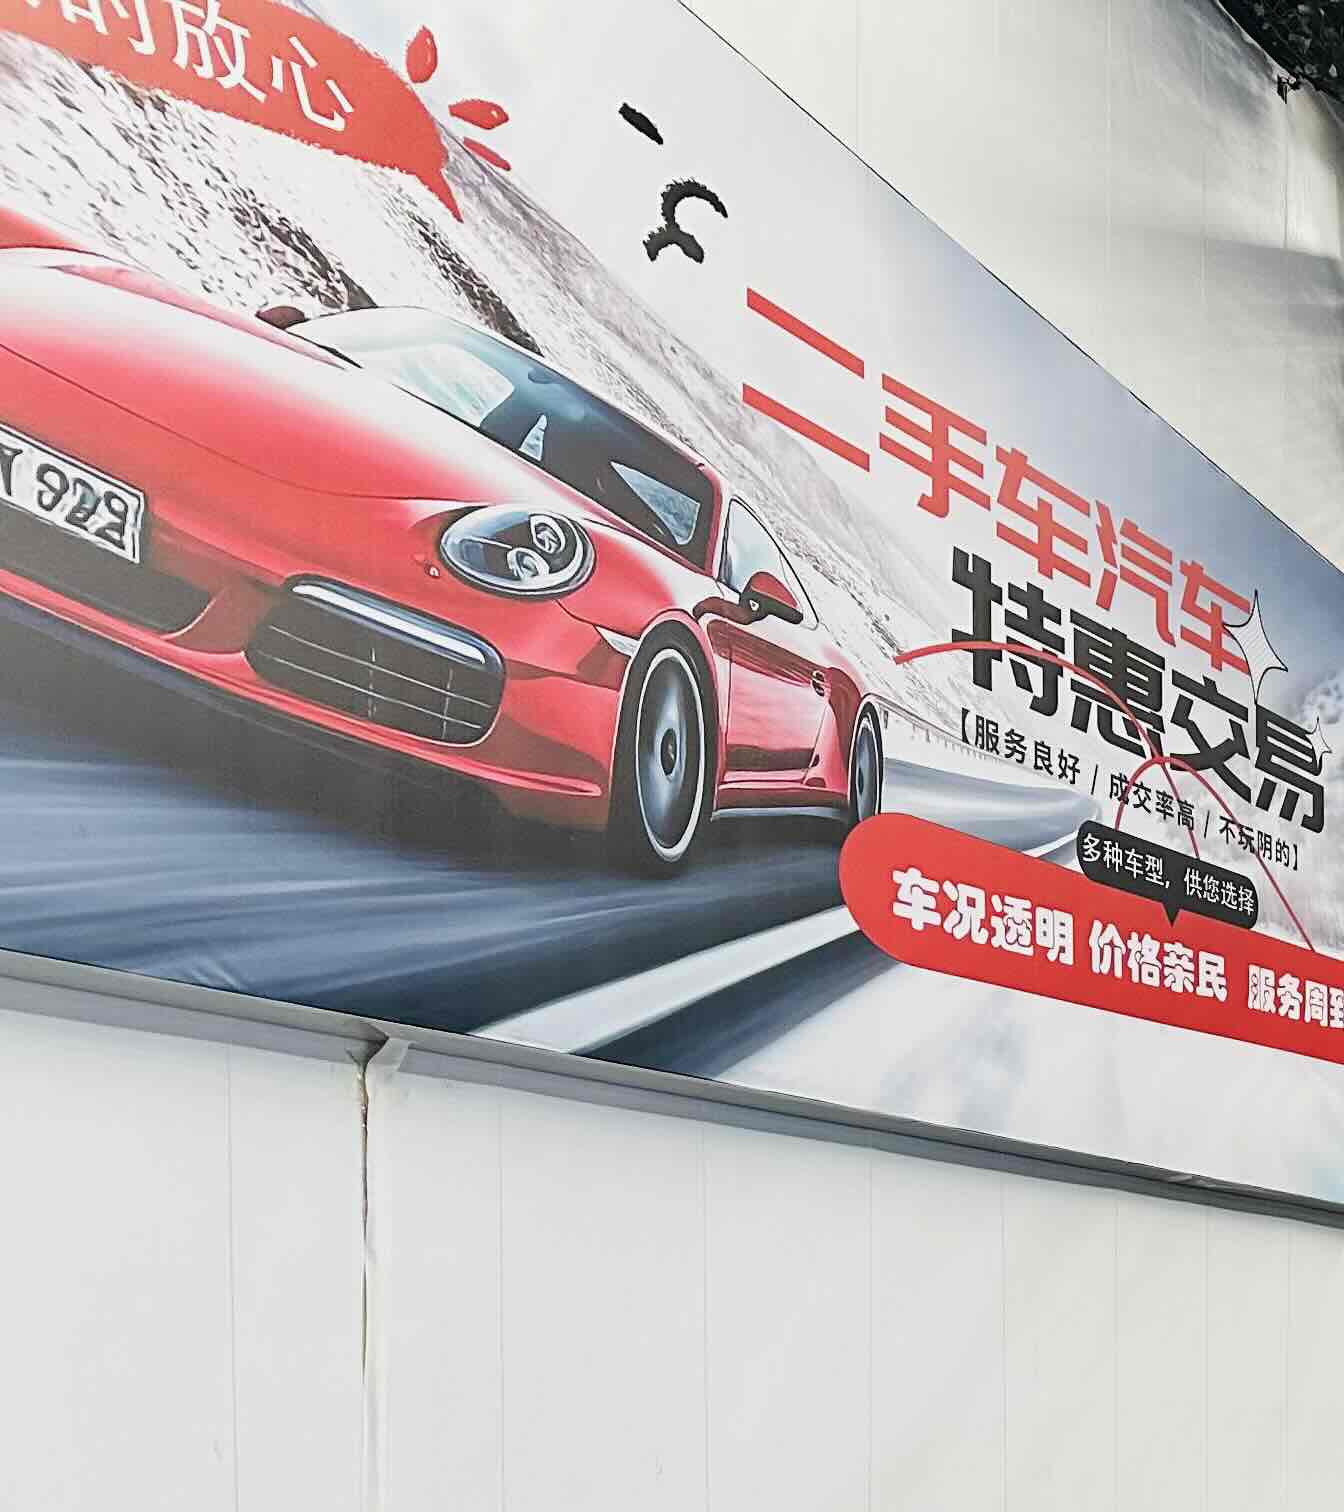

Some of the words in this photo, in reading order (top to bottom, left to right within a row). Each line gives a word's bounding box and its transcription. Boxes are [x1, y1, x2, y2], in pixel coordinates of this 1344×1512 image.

[742, 287, 1253, 676] 二手车汽车
[950, 545, 1326, 834] 特惠交易
[892, 867, 1075, 966] 车况透明
[1088, 919, 1228, 1003] 价格亲民
